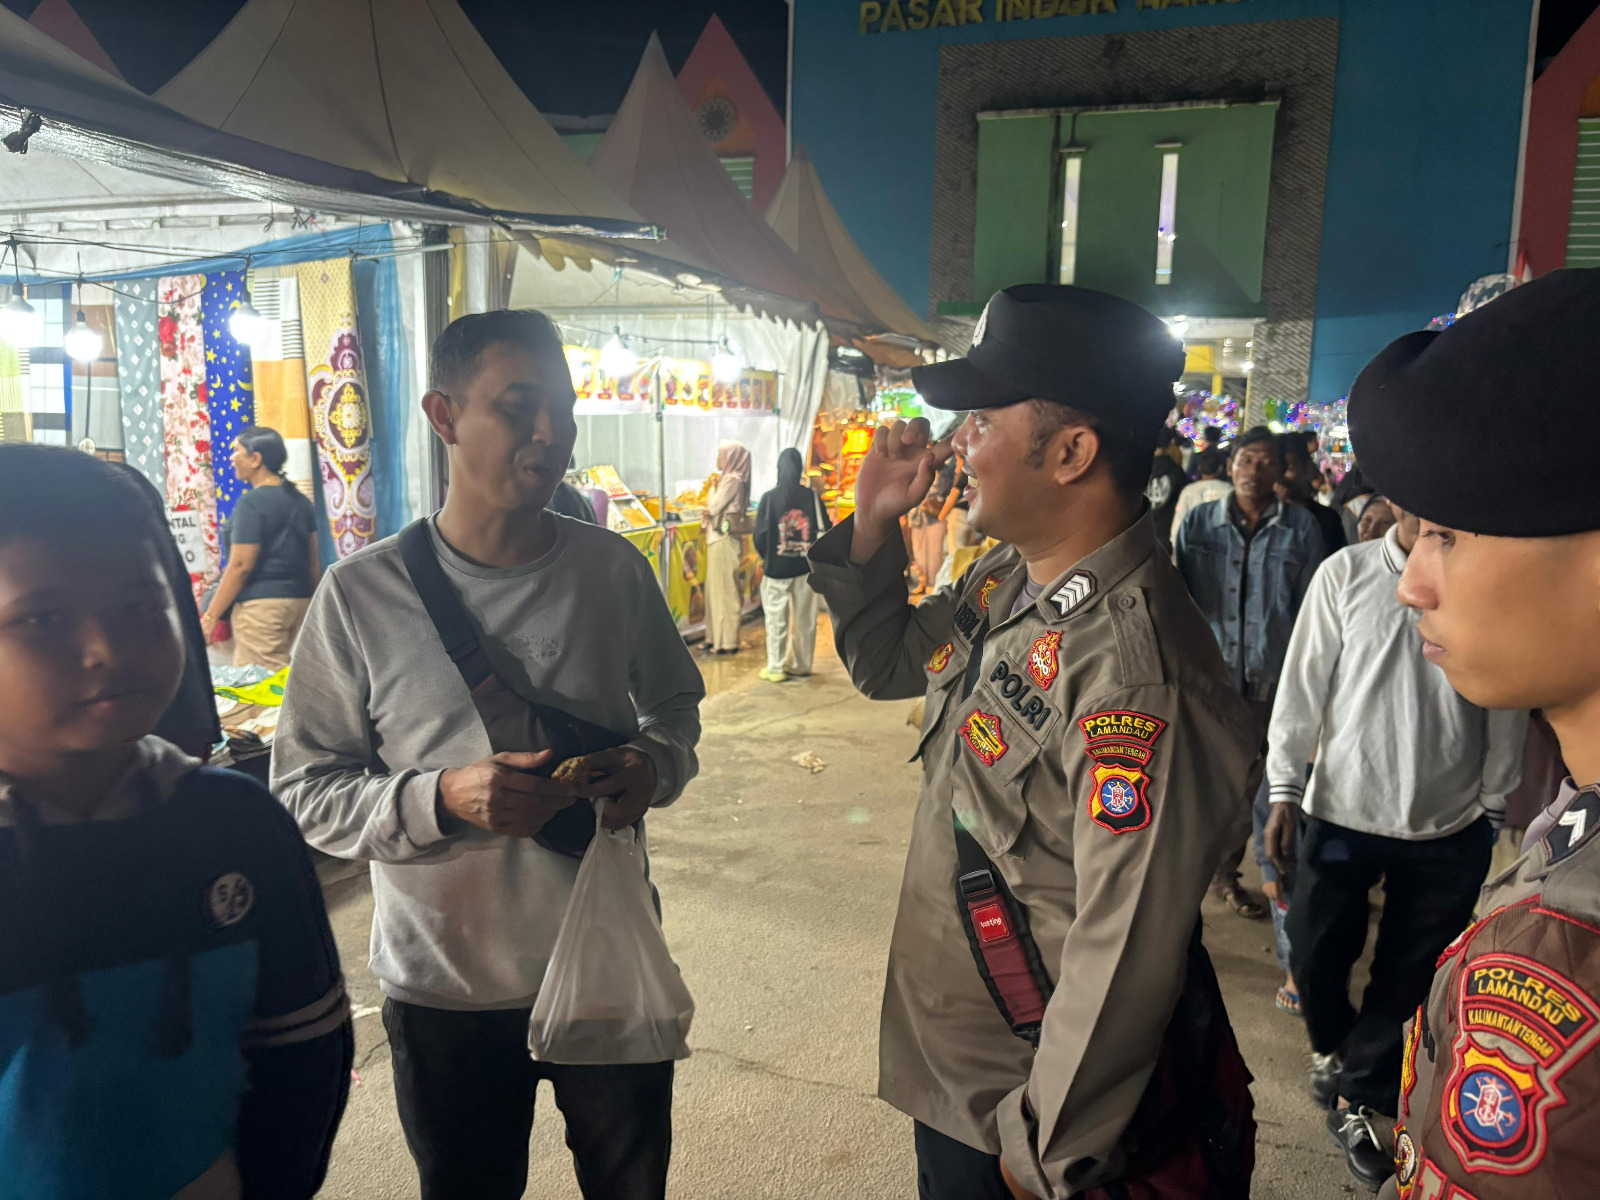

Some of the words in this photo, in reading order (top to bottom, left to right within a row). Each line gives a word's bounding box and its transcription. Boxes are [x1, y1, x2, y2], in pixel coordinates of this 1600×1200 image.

[860, 0, 983, 34] PASAR
[990, 660, 1051, 731] POLRI
[1084, 715, 1157, 732] POLRES
[1090, 725, 1149, 739] LAMANDAU
[1474, 967, 1582, 1022] POLRES
[1478, 979, 1565, 1025] LAMANDAU
[1468, 1009, 1521, 1036] KALIMANTAN
[1519, 1025, 1555, 1059] TENGAH
